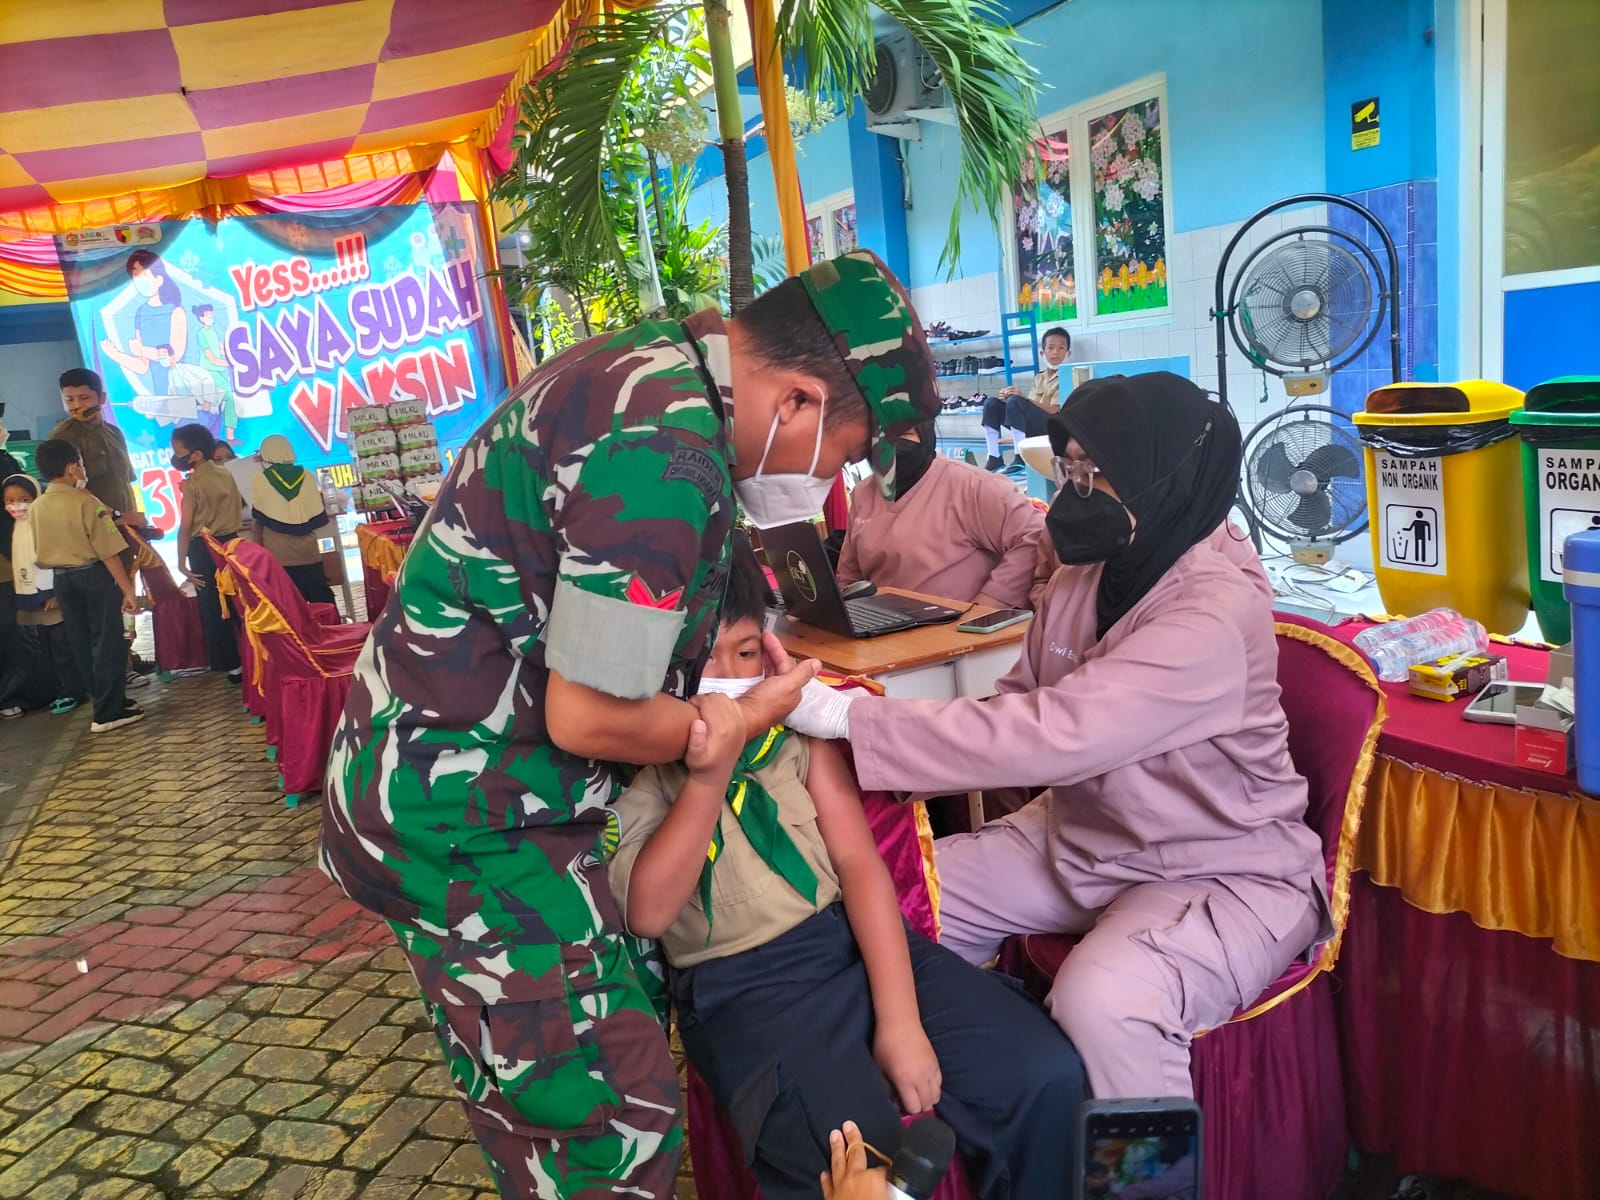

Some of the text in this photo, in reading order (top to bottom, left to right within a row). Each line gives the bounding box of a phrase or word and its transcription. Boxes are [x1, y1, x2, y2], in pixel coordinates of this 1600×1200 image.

[227, 259, 481, 391] SAYA SUDAH
[291, 343, 475, 447] VAKSIN
[1381, 459, 1437, 471] SAMPAH
[1546, 456, 1600, 470] SAMP
[1382, 472, 1438, 490] NON ORGANIK
